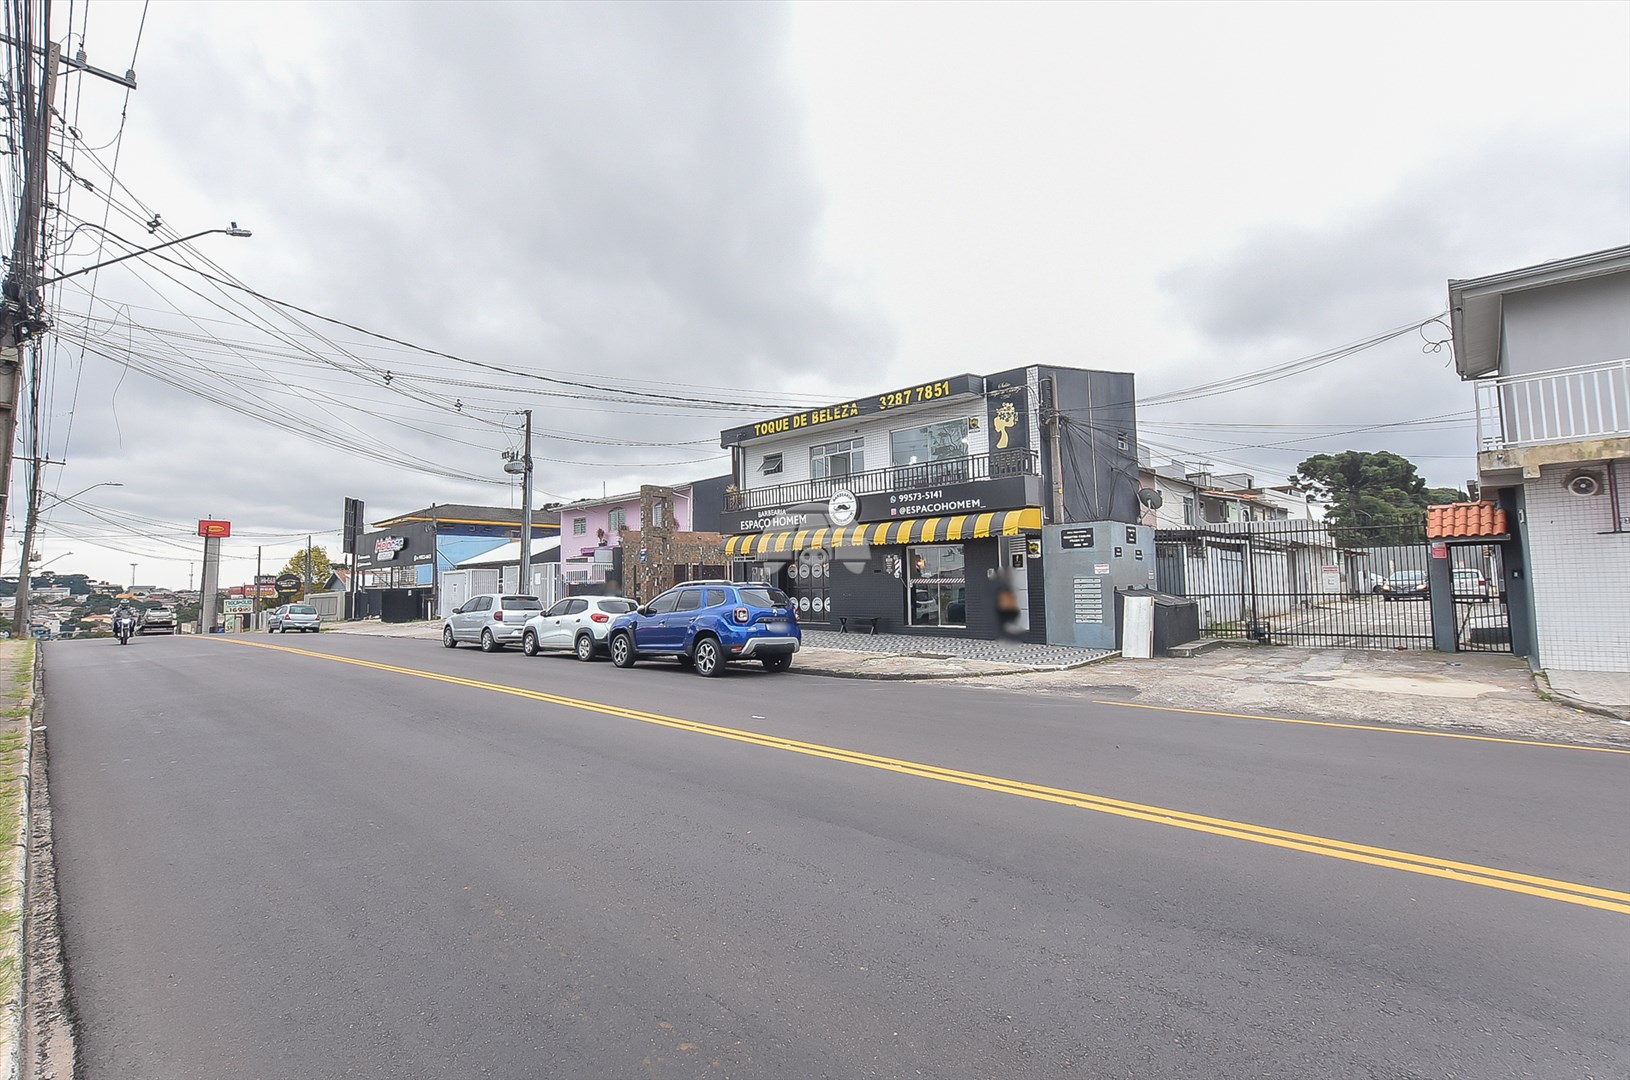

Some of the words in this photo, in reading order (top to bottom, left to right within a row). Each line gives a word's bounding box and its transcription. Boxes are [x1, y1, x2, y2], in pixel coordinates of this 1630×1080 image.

[879, 389, 912, 410] 3287
[916, 381, 950, 401] 7851
[754, 417, 789, 436] TOQUE
[793, 413, 808, 429] DE
[811, 402, 859, 425] BELEZA
[898, 490, 943, 503] 99573-5141
[757, 509, 787, 518] BARBEARIA
[740, 517, 771, 531] ESPAÇO
[772, 514, 807, 527] HOMEM
